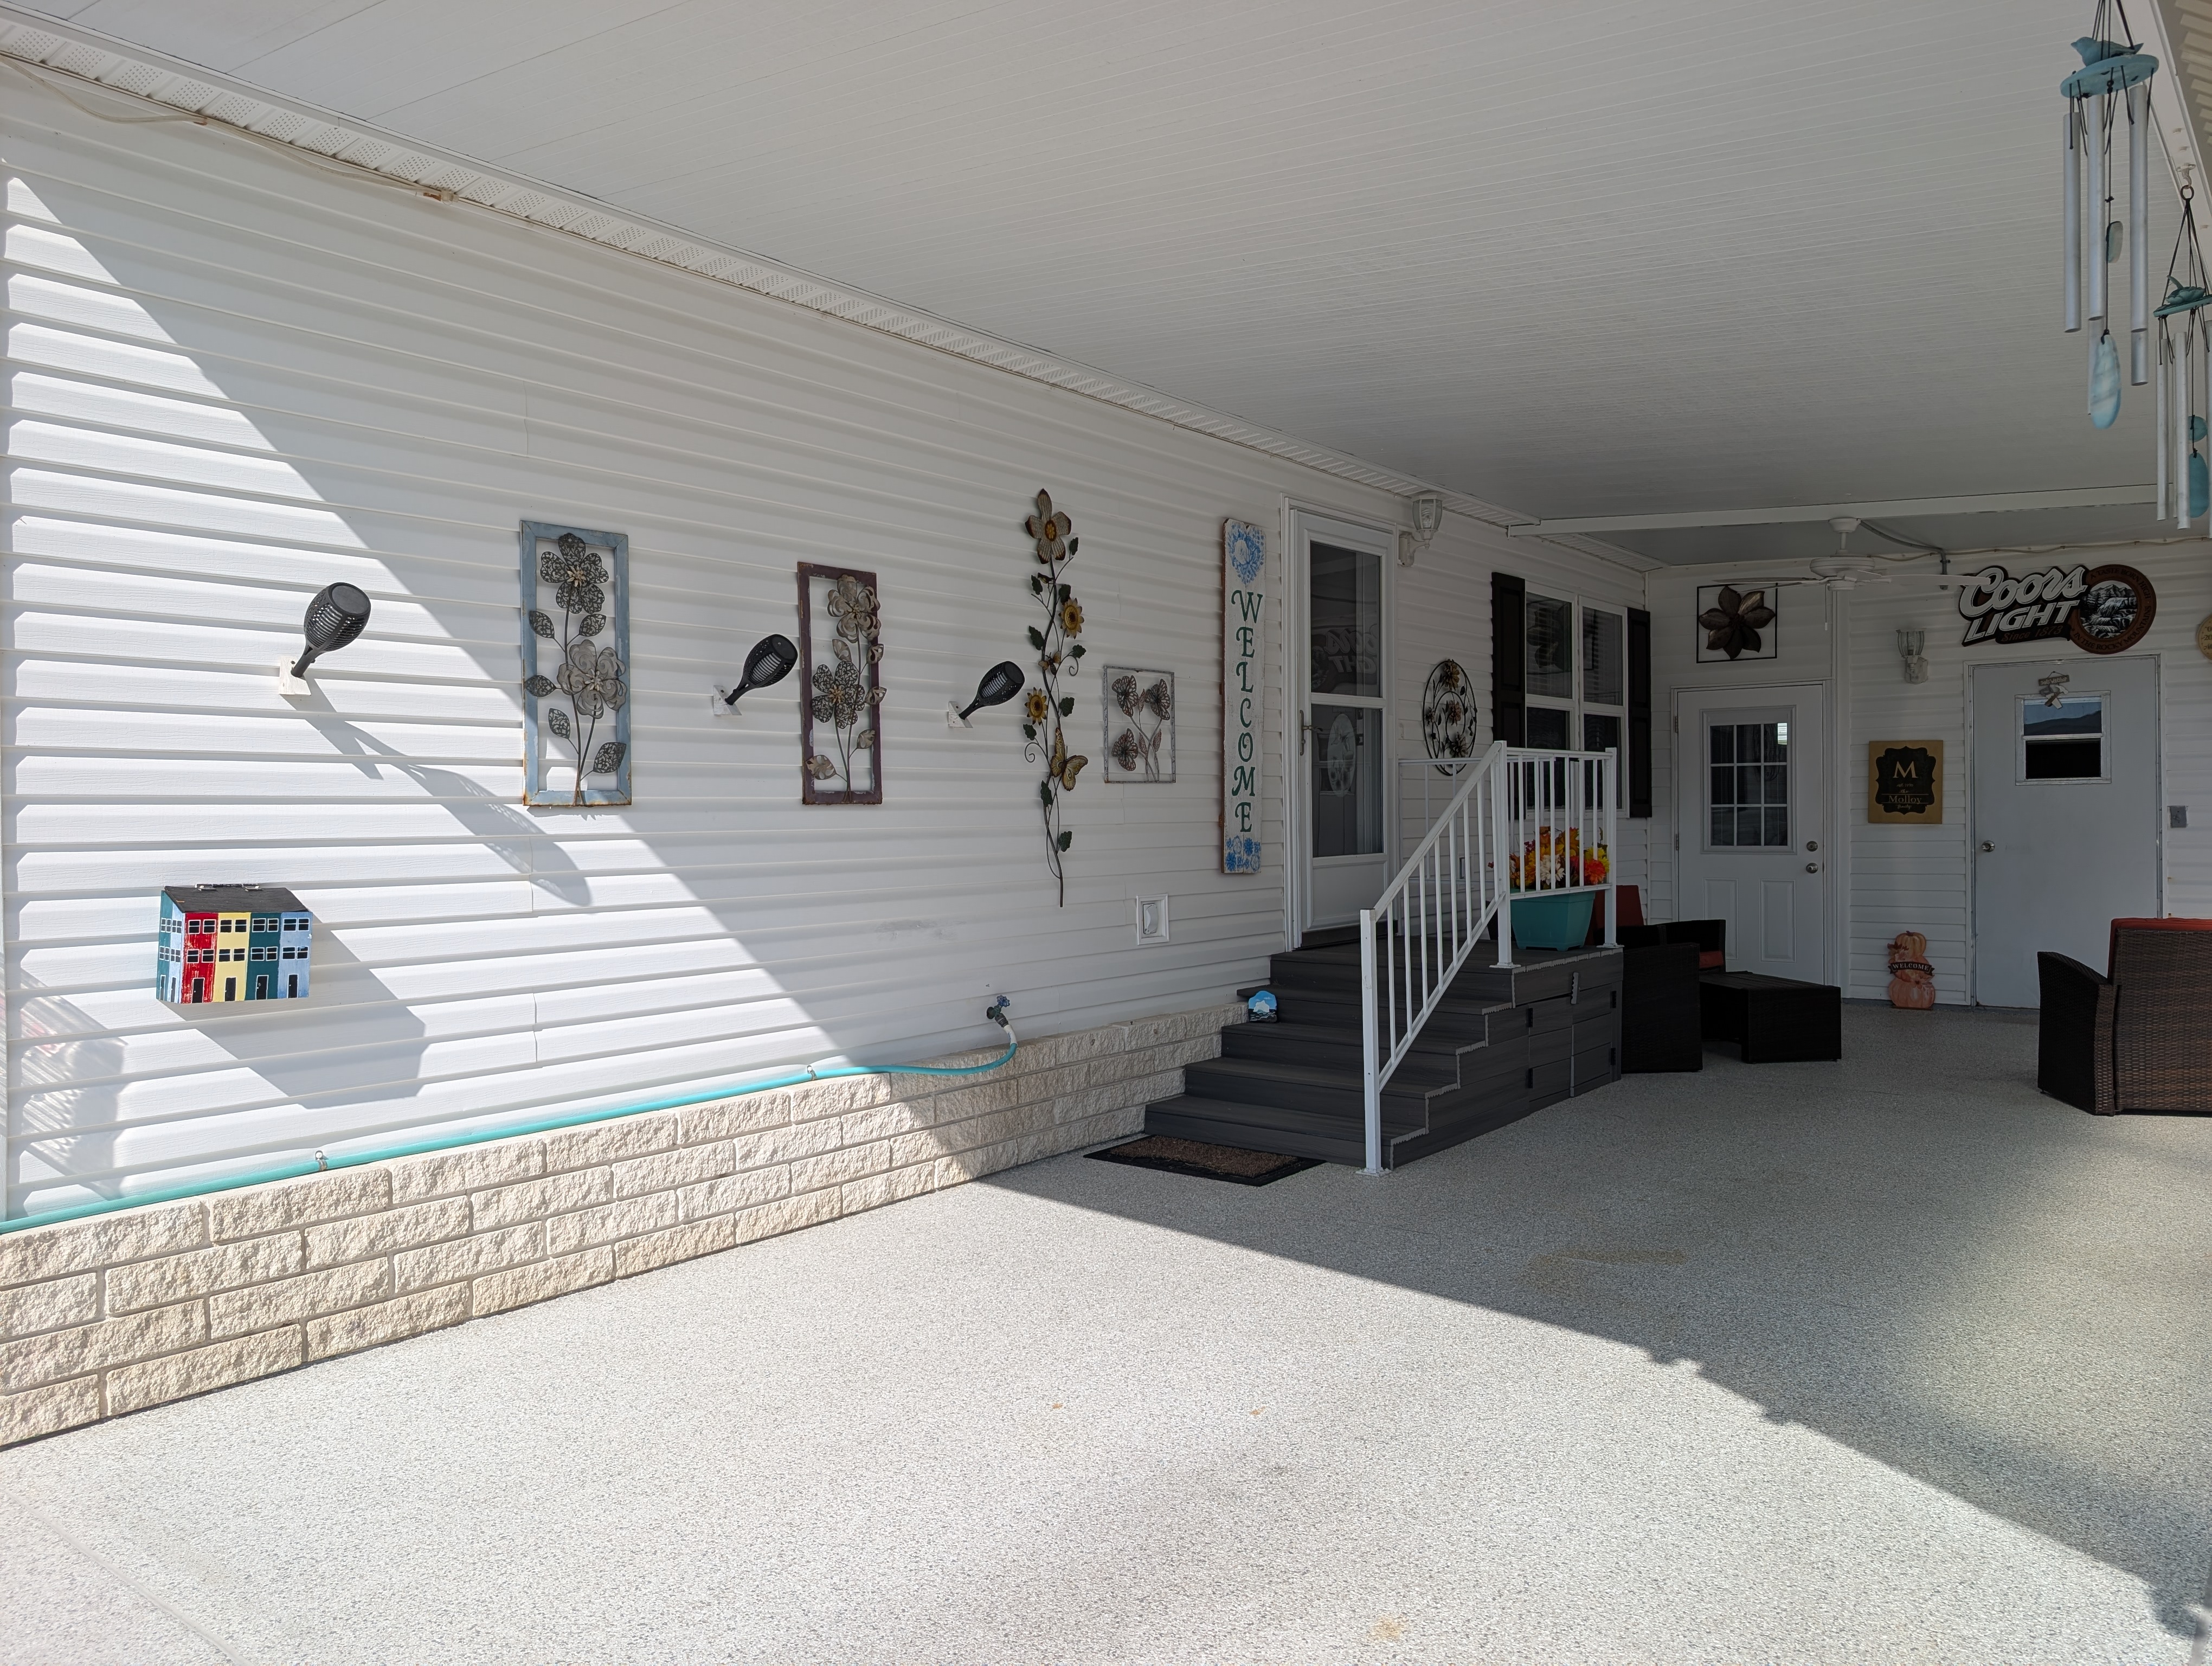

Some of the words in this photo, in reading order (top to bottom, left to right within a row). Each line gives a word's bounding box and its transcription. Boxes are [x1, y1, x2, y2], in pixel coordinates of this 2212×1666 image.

[1959, 567, 2088, 617] Coors
[2097, 568, 2119, 576] TASTE
[2121, 569, 2141, 582] BORN
[2139, 581, 2151, 599] HIGH
[1964, 600, 2081, 643] LIGHT
[2002, 631, 2030, 642] Since
[2035, 625, 2063, 637] 1873
[2081, 638, 2095, 649] THE
[2095, 641, 2123, 650] ROCKY
[2124, 606, 2151, 644] MOUNTAINS
[1231, 589, 1263, 832] WELCOME
[1893, 761, 1919, 778] M
[1888, 794, 1922, 804] Molloy
[1892, 963, 1930, 971] WELCOME
